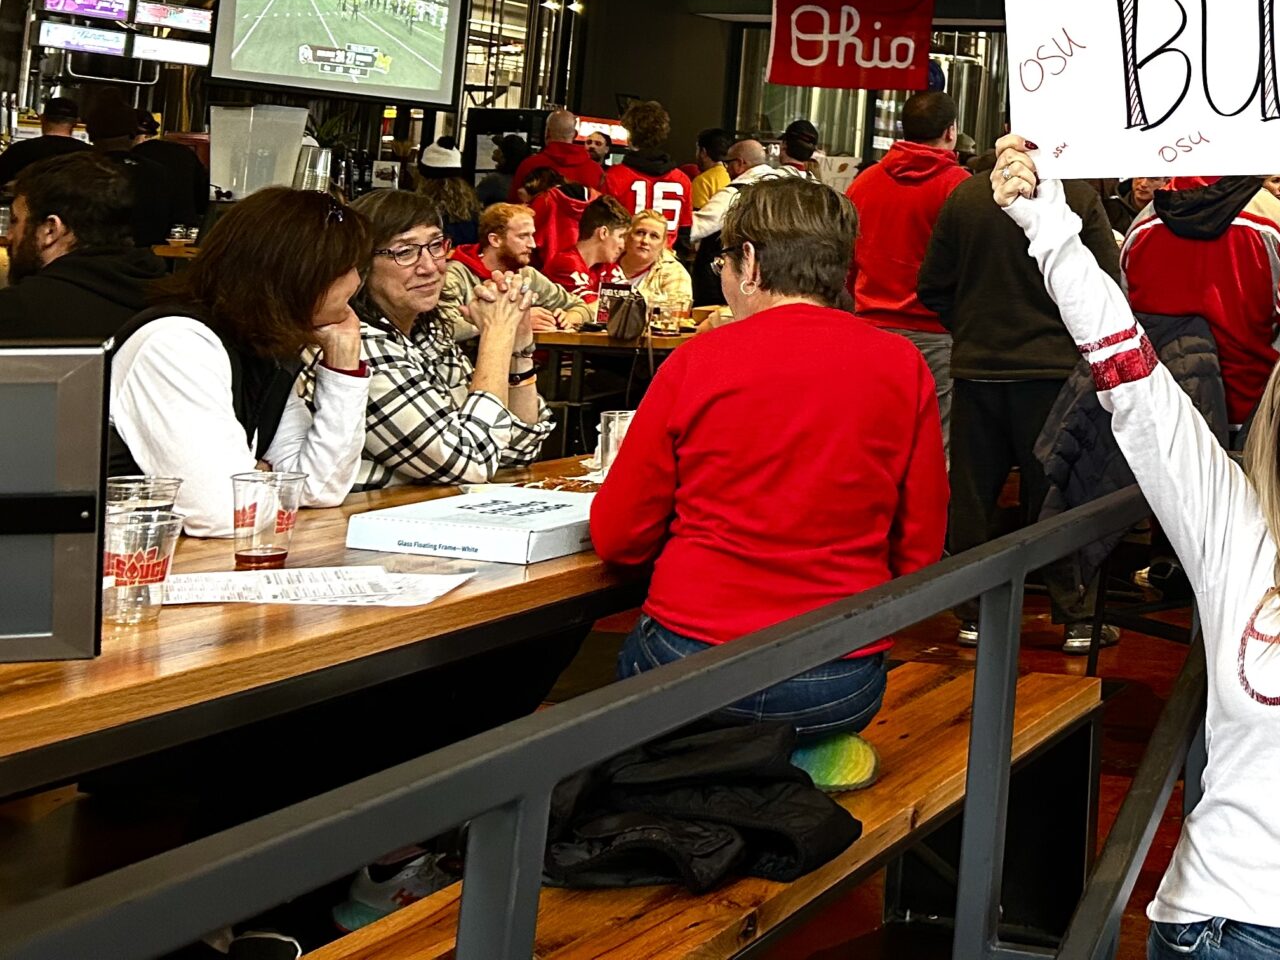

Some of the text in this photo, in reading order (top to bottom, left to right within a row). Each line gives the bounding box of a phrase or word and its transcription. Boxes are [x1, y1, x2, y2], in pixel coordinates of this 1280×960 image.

[790, 4, 916, 69] Ohio
[1019, 27, 1086, 93] OSU
[1159, 132, 1210, 163] OSU
[631, 180, 684, 231] 16
[413, 541, 437, 551] Floating
